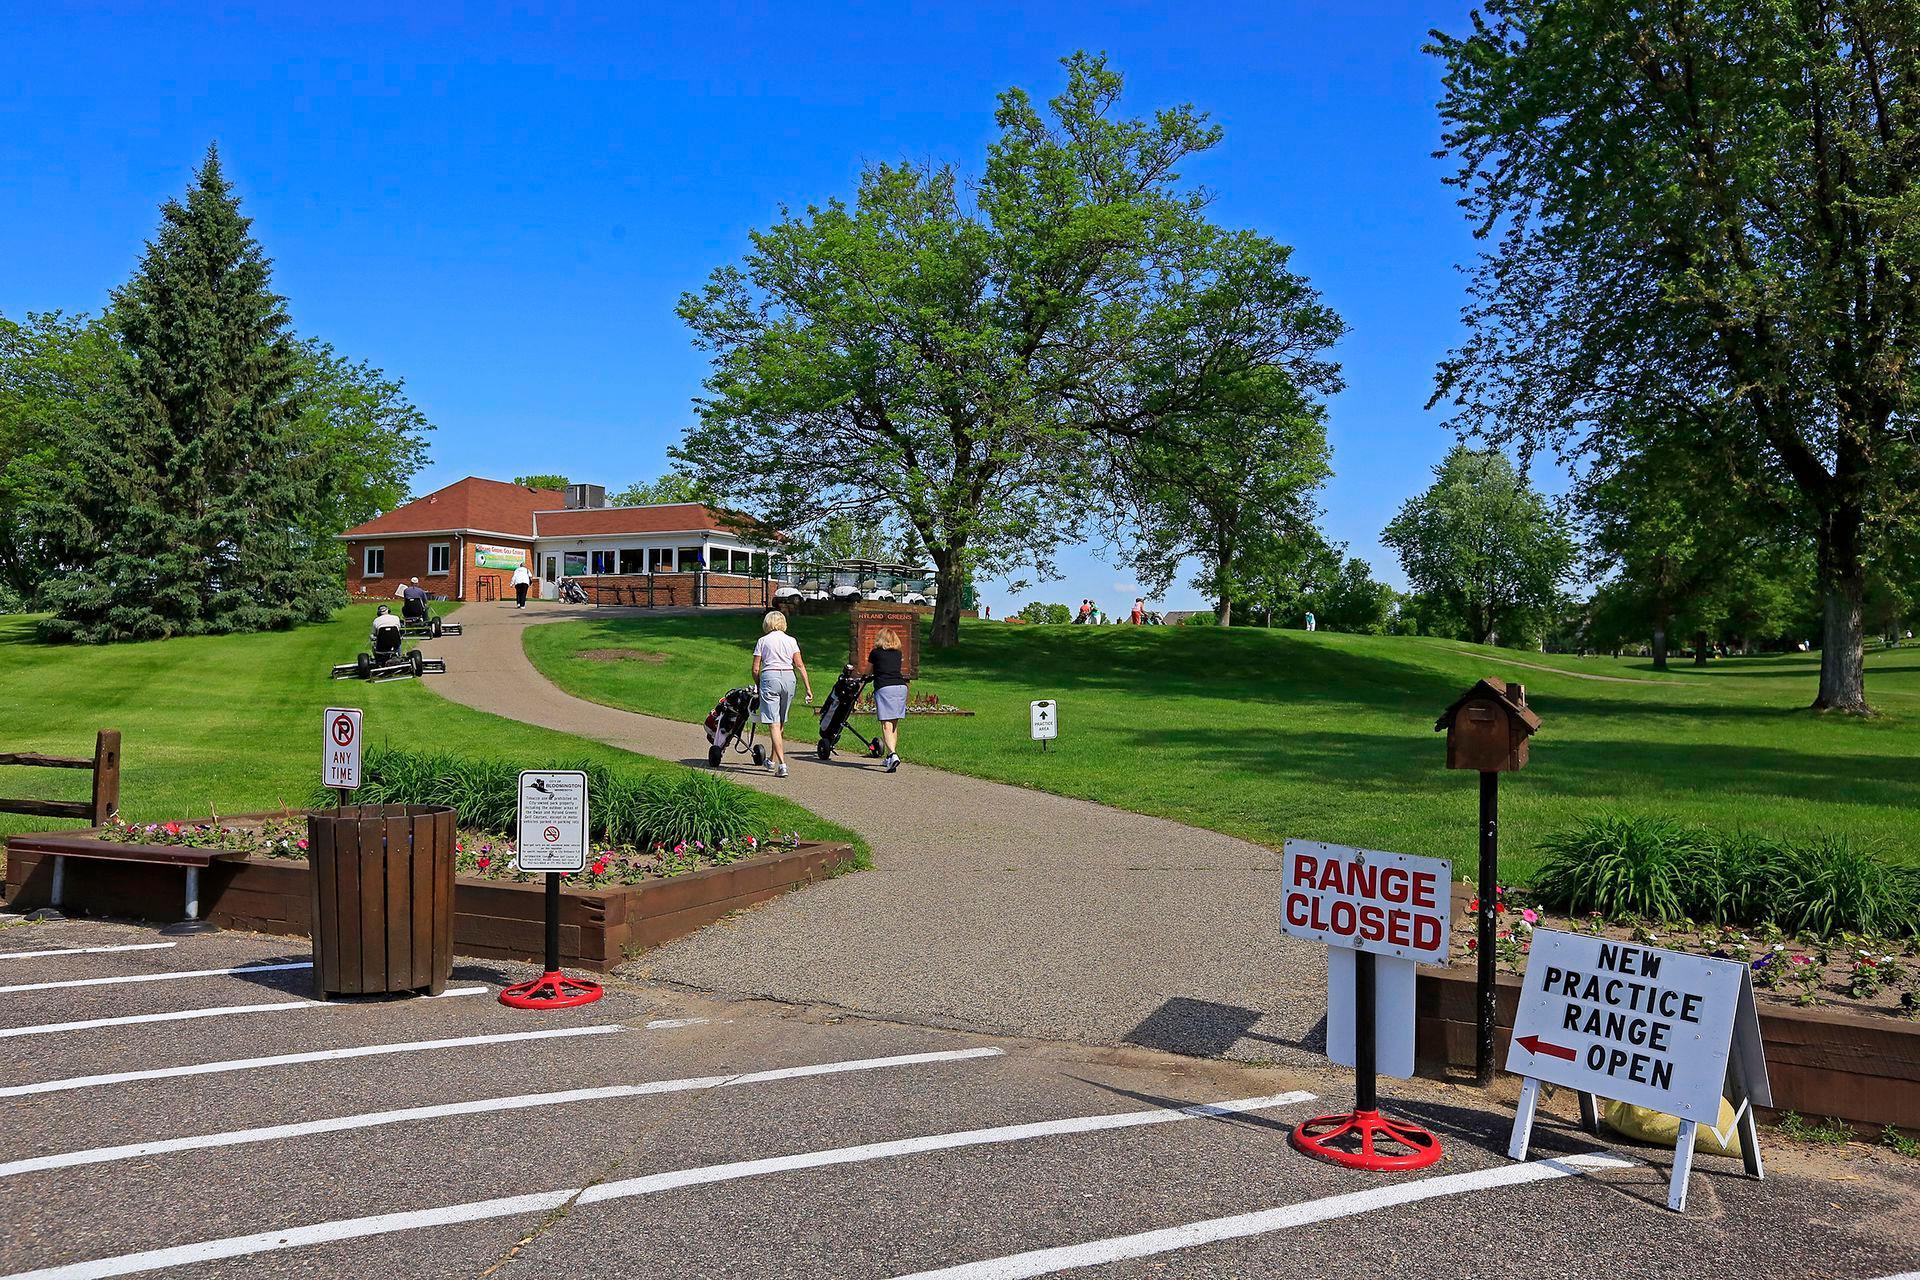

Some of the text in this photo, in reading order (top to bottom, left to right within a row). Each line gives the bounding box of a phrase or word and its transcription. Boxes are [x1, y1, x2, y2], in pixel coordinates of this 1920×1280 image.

[332, 766, 352, 780] TIME
[333, 751, 352, 764] ANY
[1294, 854, 1436, 908] RANGE
[1286, 892, 1442, 951] CLOSED
[1598, 944, 1662, 979] NEW
[1543, 966, 1703, 1023] PRACTICE
[1563, 1003, 1671, 1052] RANGE
[1587, 1044, 1673, 1090] OPEN
